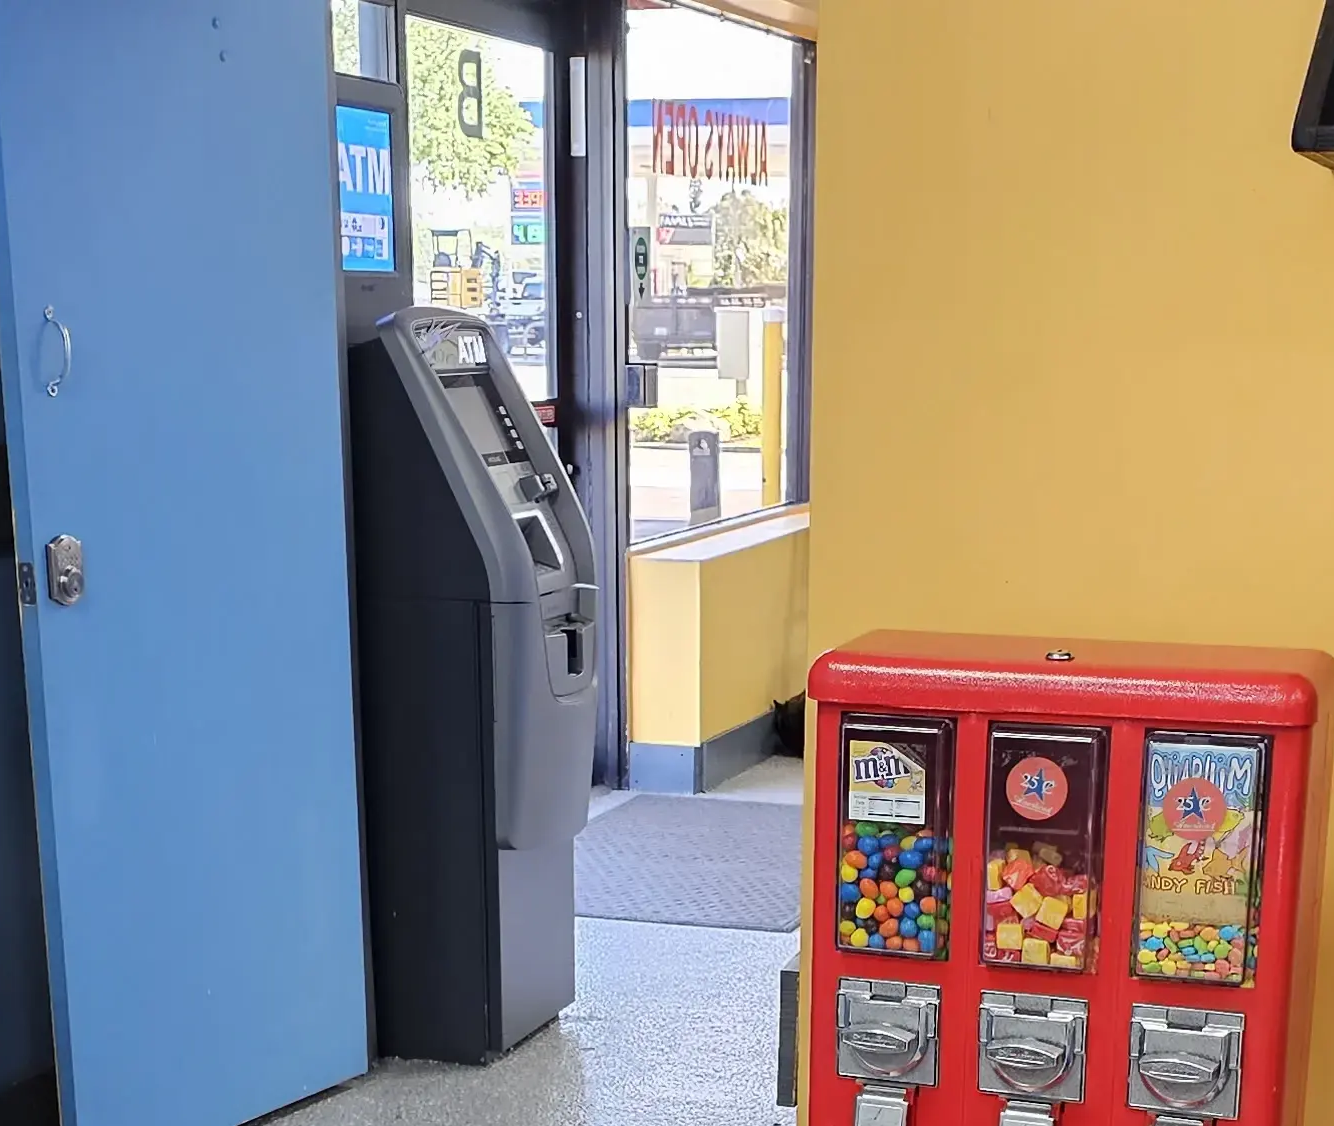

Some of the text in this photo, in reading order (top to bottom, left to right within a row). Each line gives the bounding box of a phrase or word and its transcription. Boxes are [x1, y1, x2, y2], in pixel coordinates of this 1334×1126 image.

[338, 141, 392, 195] ATM
[457, 335, 487, 365] ATM
[1194, 878, 1238, 895] FISH
